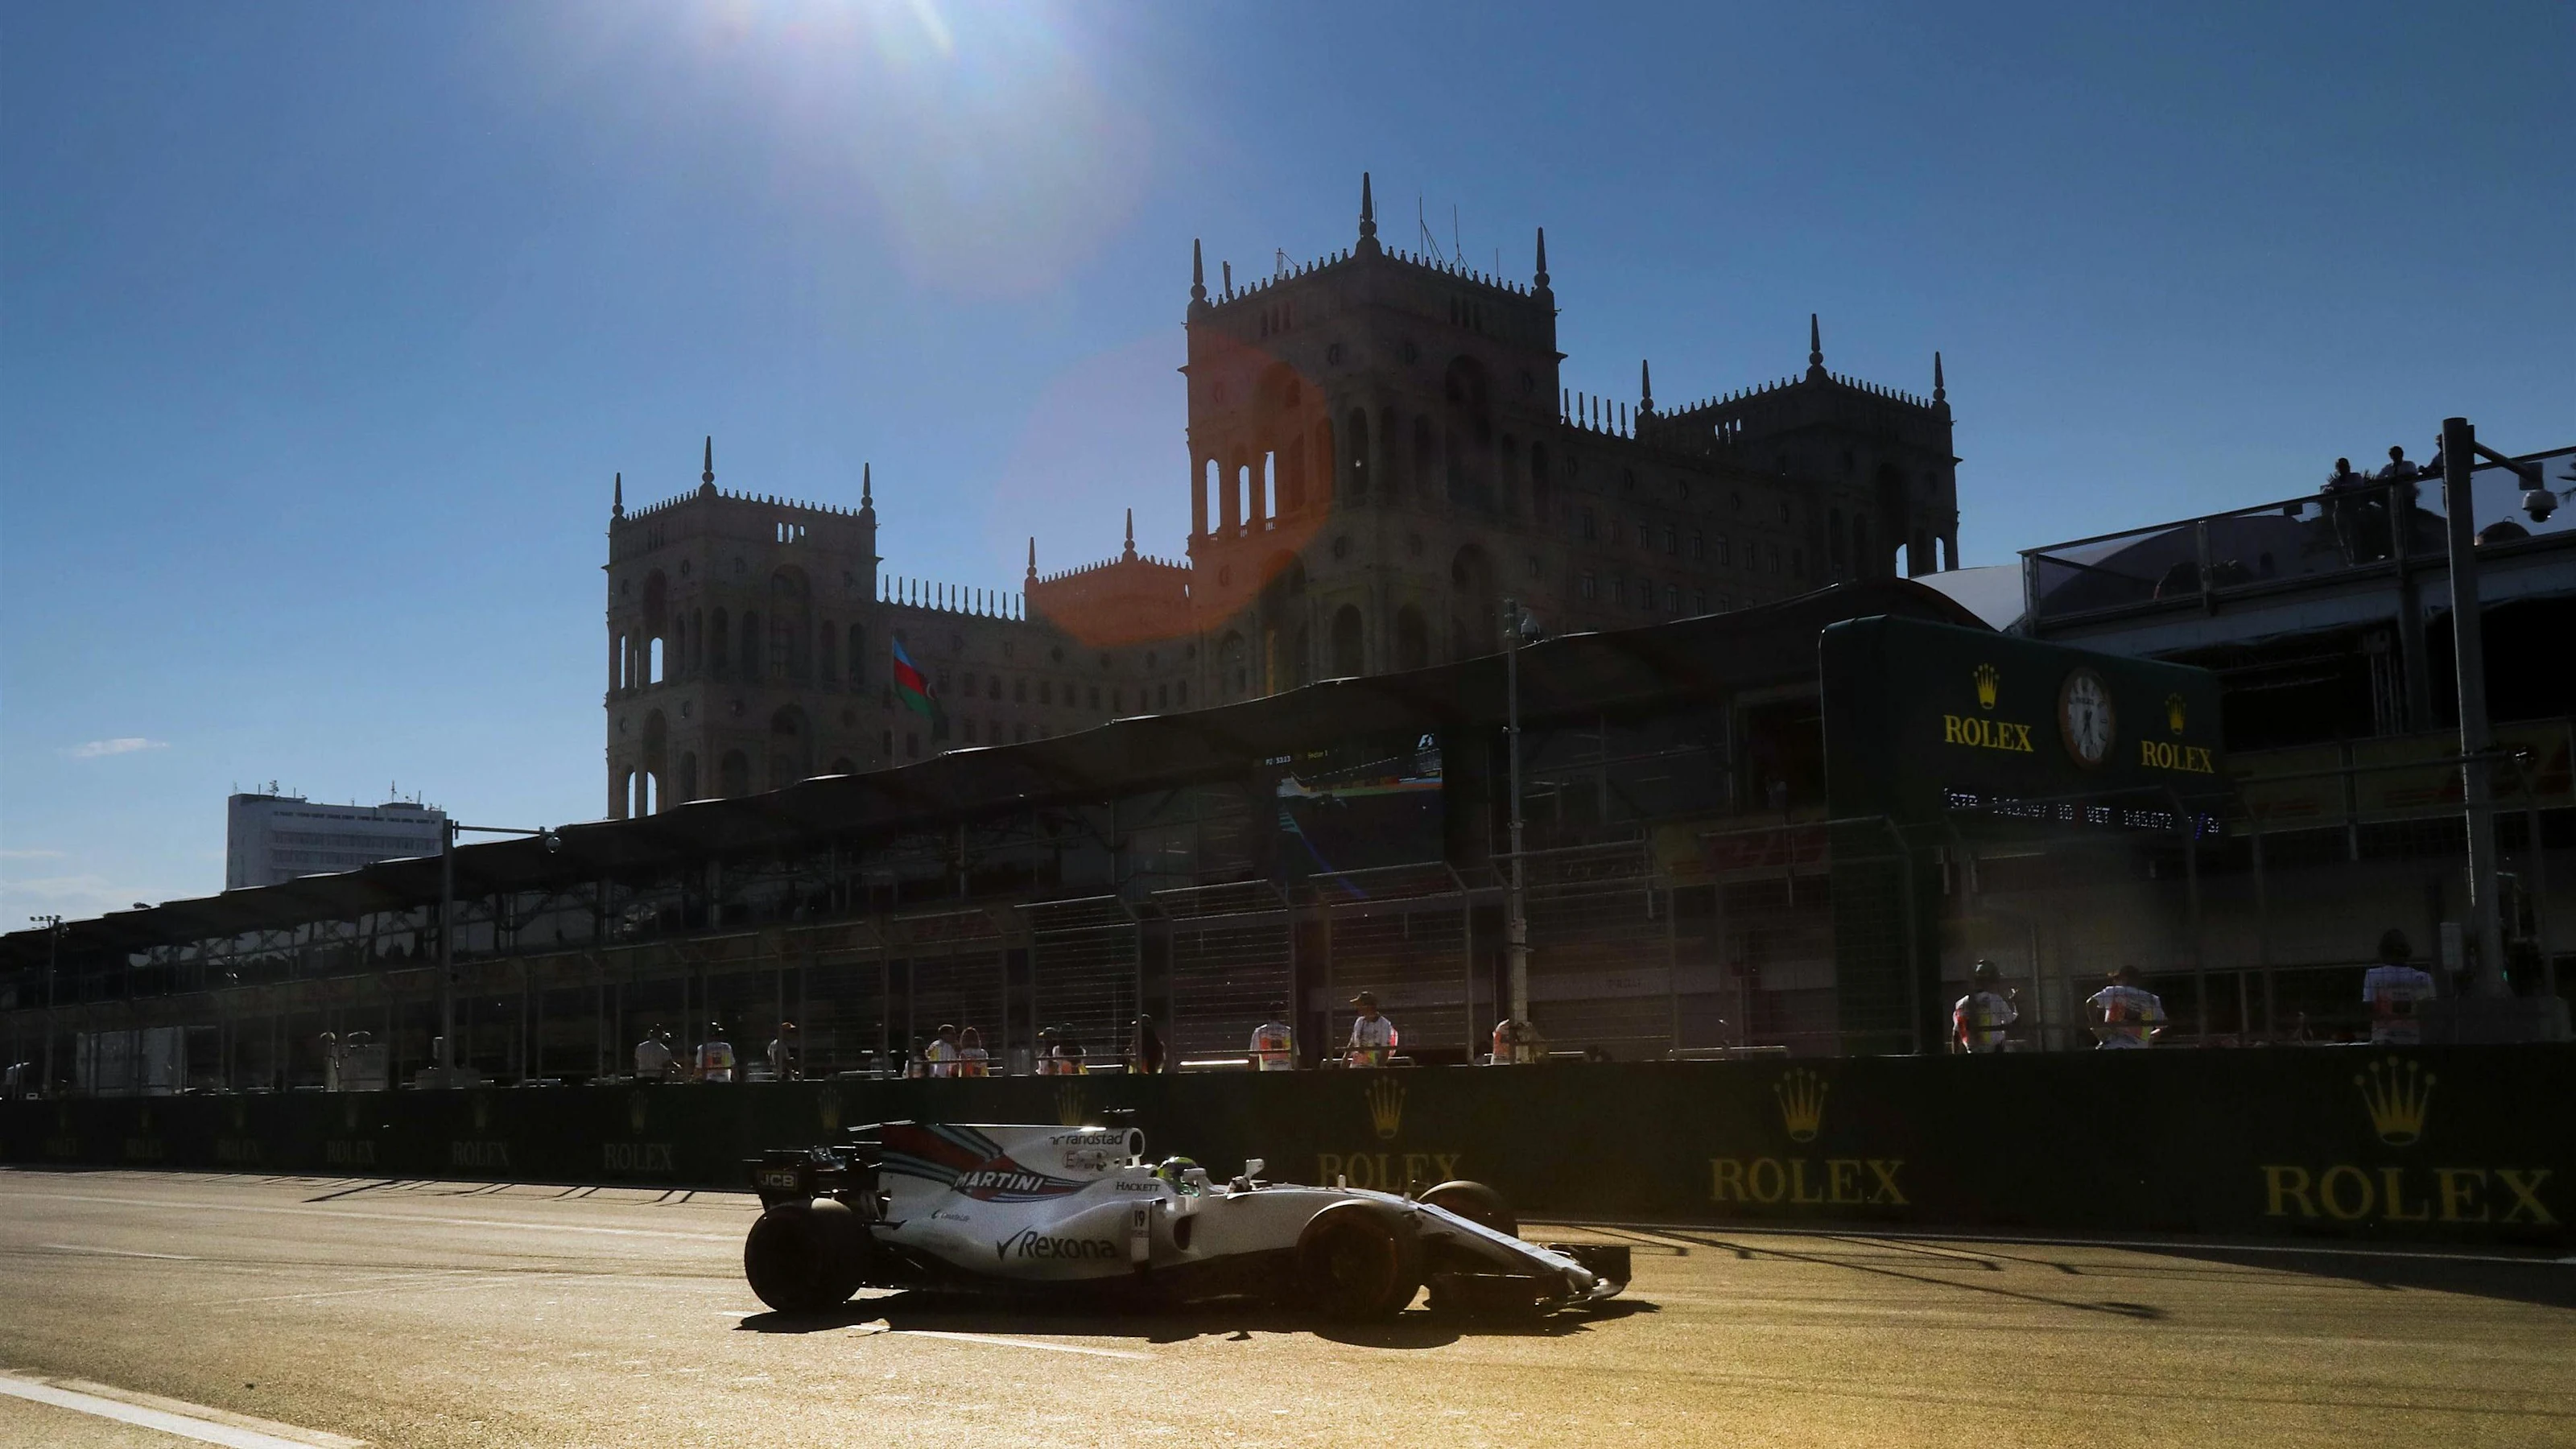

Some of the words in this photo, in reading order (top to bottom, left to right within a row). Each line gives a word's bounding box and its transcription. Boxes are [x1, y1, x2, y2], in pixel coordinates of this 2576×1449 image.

[1942, 714, 2034, 753] ROLEX
[2140, 740, 2215, 774] ROLEX
[1066, 1129, 1126, 1145] randstad
[327, 1140, 375, 1165] ROLEX
[452, 1141, 510, 1166] ROLEX
[604, 1142, 674, 1171] ROLEX
[760, 1174, 795, 1187] JCB
[953, 1170, 1045, 1191] MARTINI
[1318, 1153, 1461, 1191] ROLEX
[1709, 1158, 1910, 1206] ROLEX
[1116, 1181, 1160, 1192] HACKETT
[2260, 1165, 2560, 1225] ROLEX
[1134, 1210, 1145, 1227] 19
[1018, 1231, 1117, 1259] Rexona
